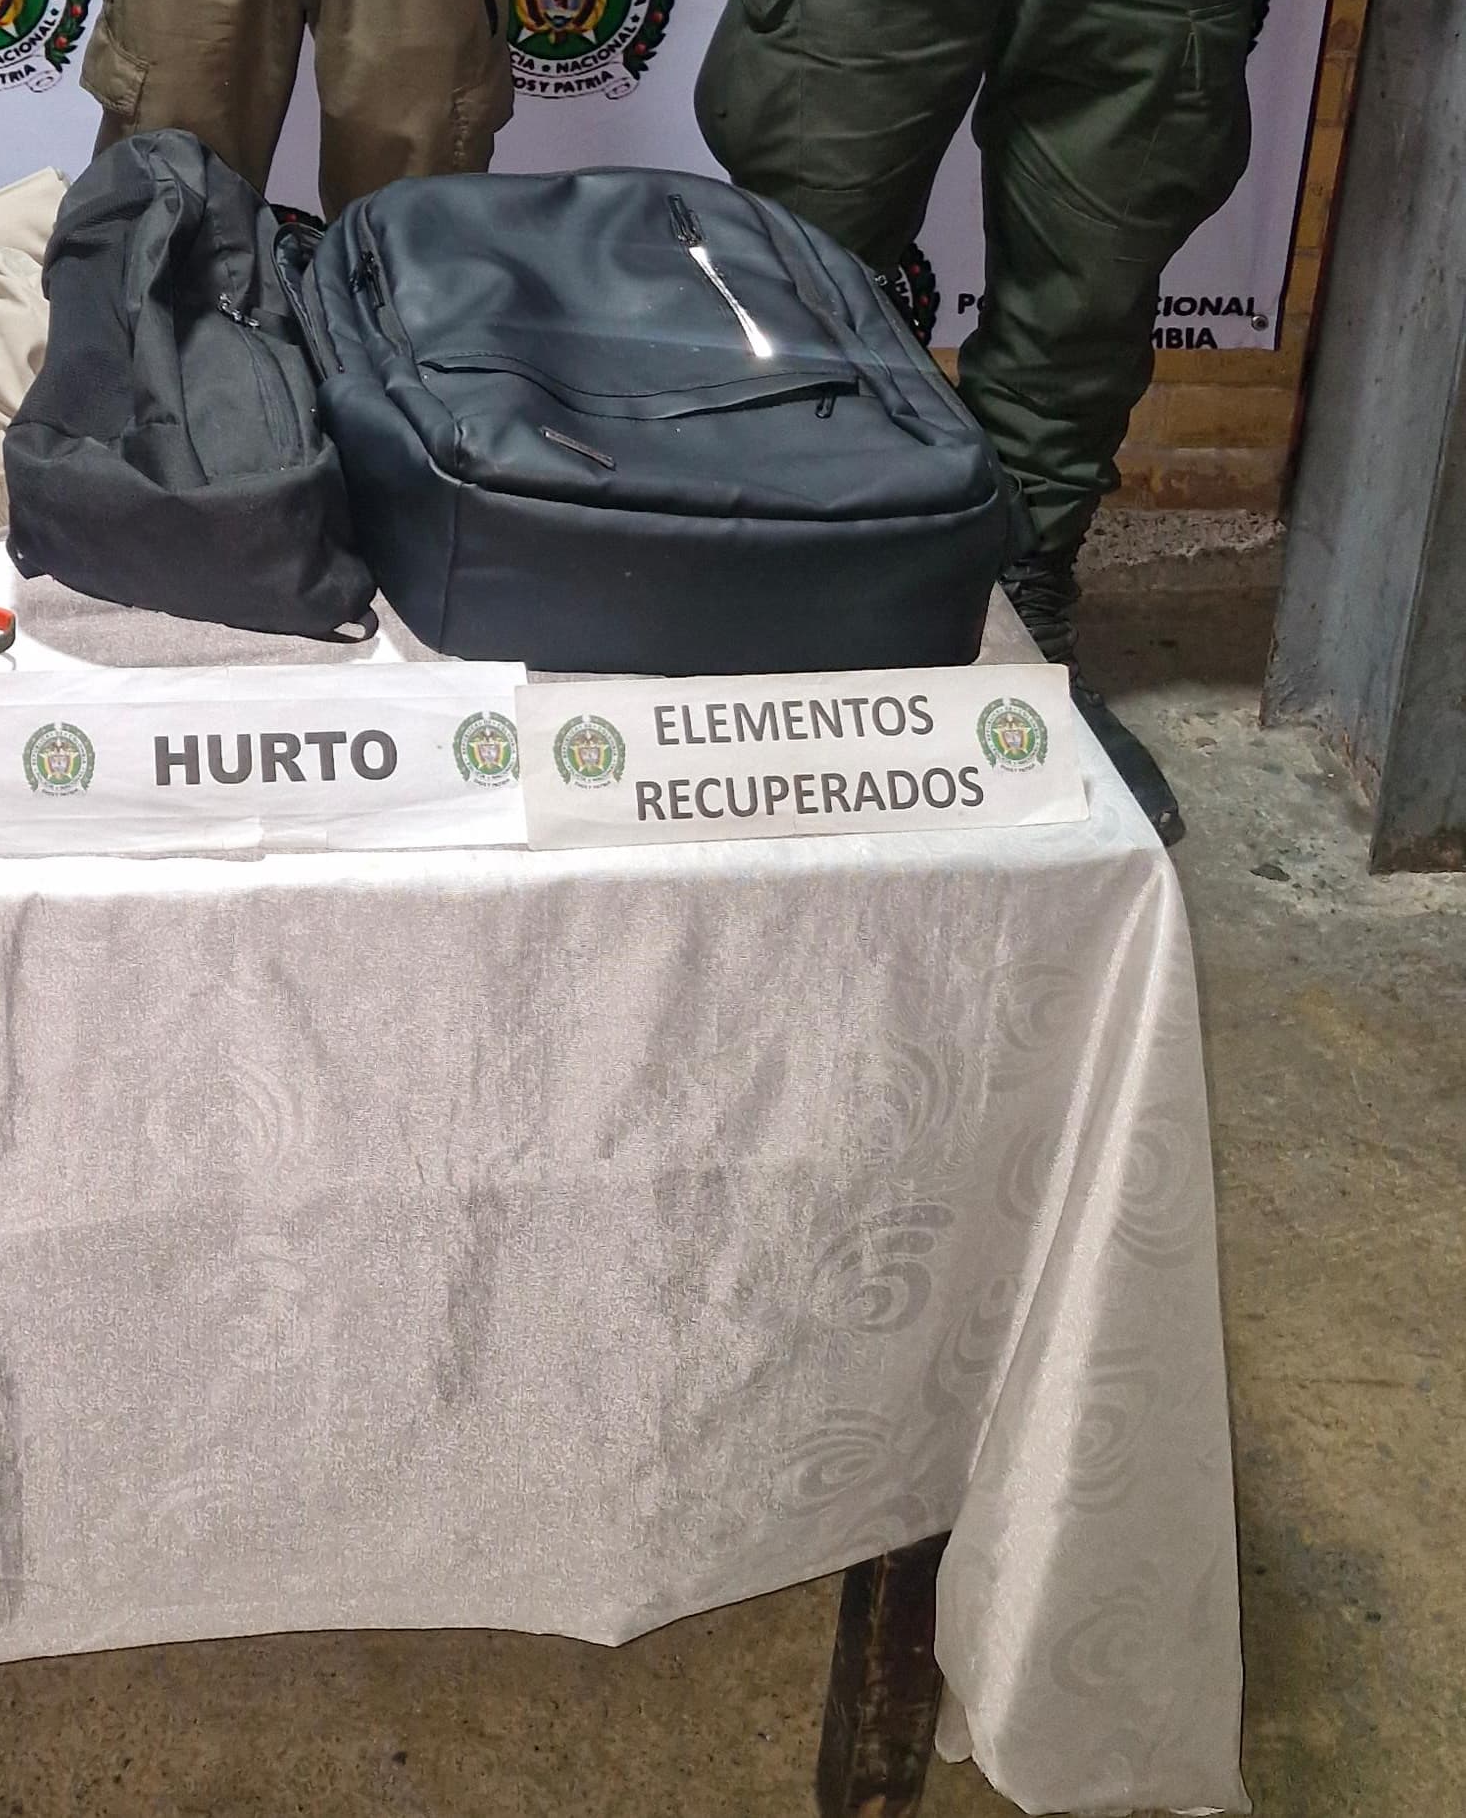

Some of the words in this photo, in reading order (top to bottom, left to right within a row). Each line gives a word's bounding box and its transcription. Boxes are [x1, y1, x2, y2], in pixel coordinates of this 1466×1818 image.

[555, 26, 636, 74] NACIONAL
[538, 81, 550, 93] Y
[553, 71, 615, 93] PATRIA
[654, 694, 934, 746] ELEMENTOS
[154, 729, 398, 786] HURTO
[635, 766, 984, 822] RECUPERADOS
